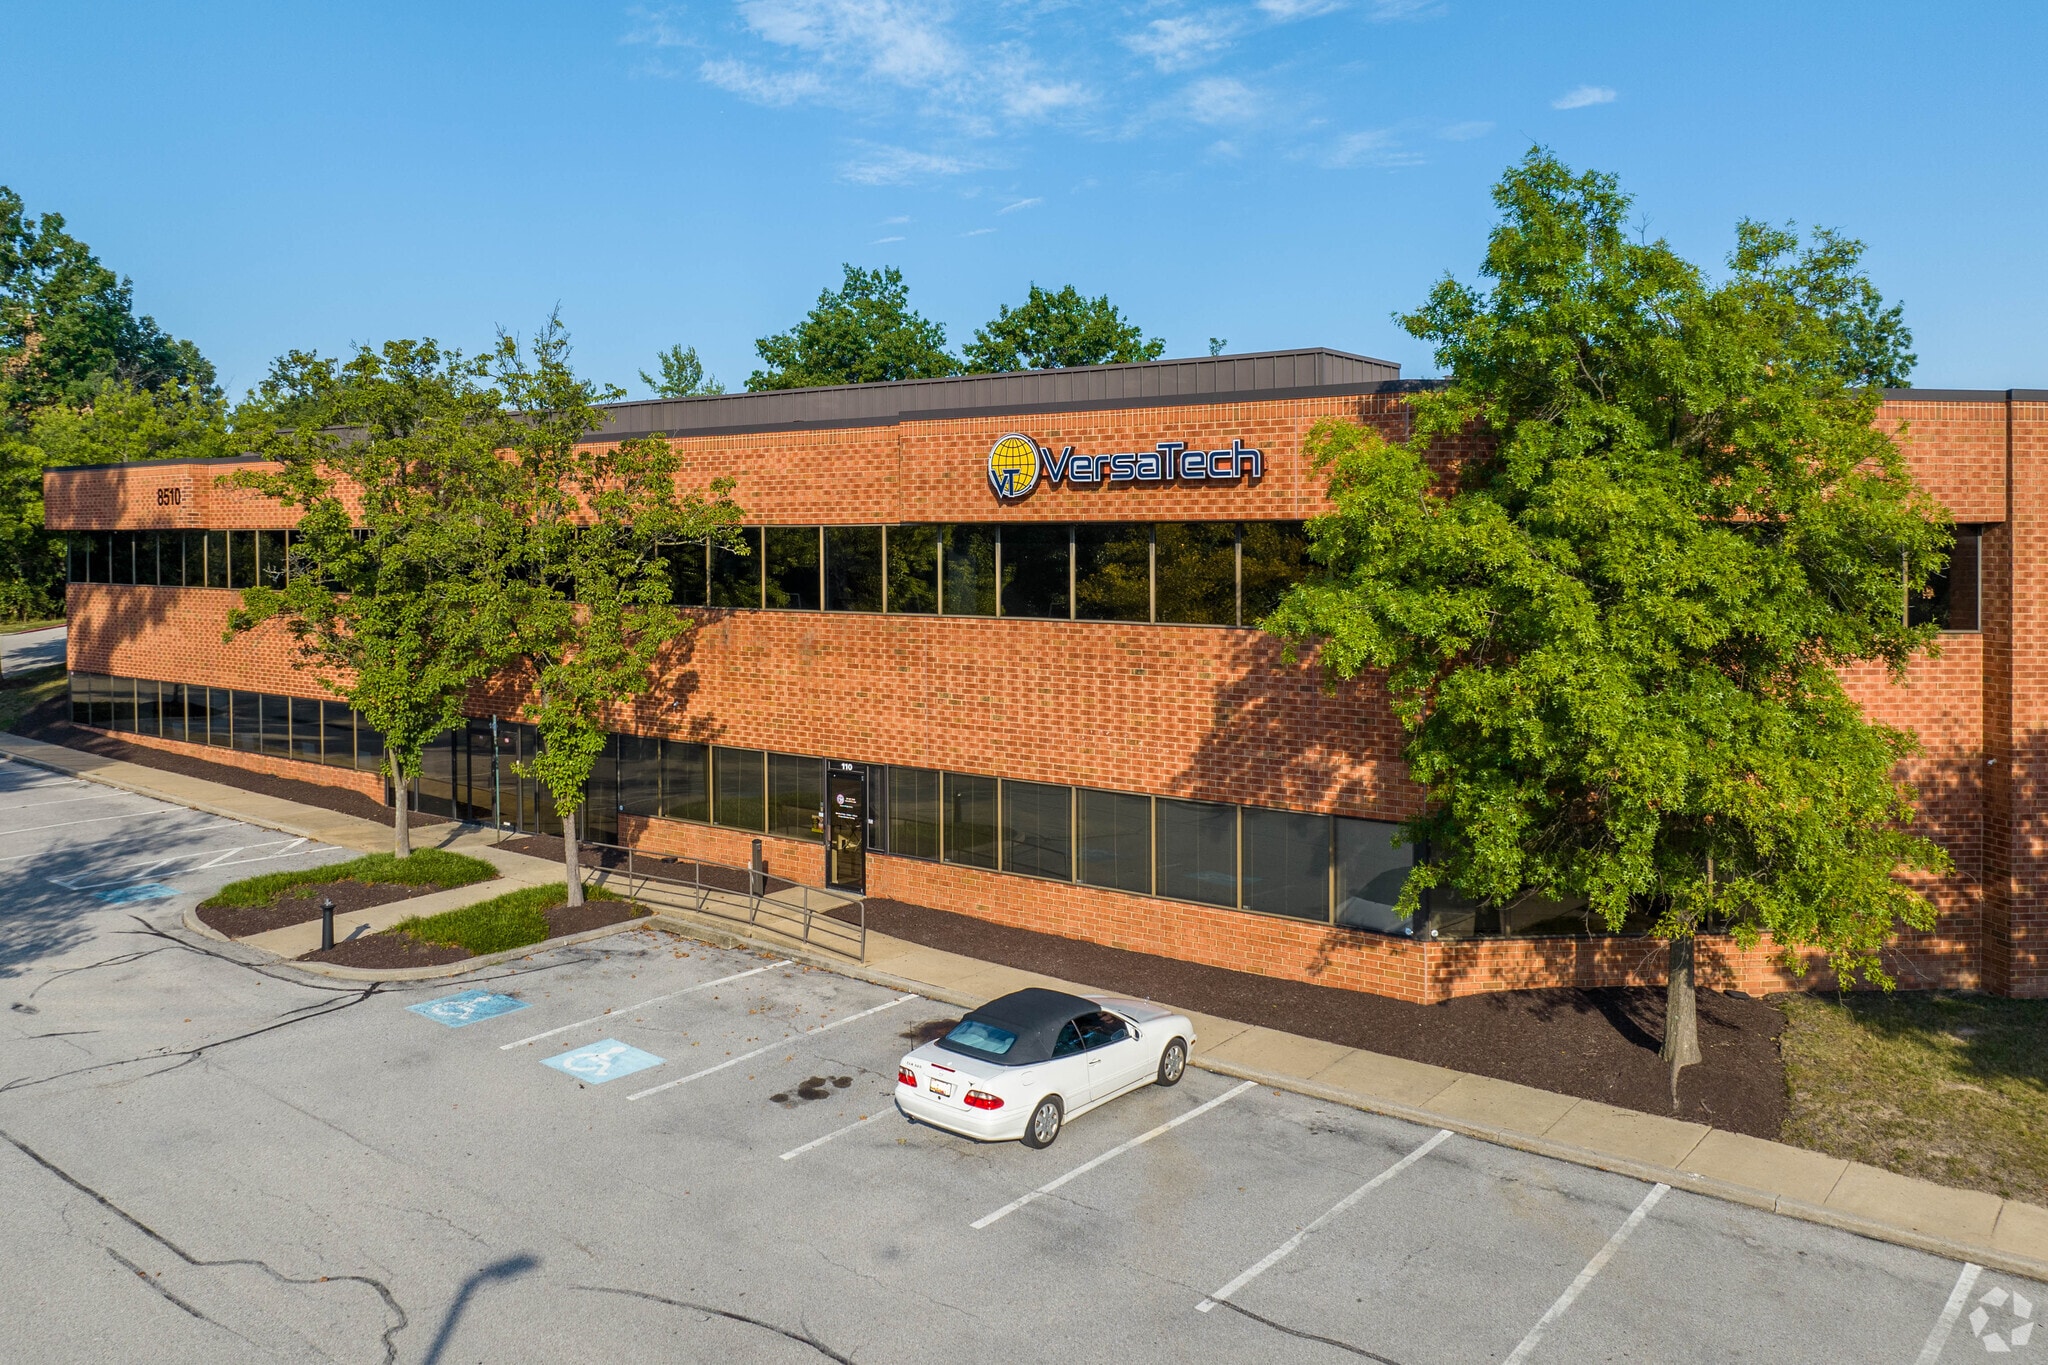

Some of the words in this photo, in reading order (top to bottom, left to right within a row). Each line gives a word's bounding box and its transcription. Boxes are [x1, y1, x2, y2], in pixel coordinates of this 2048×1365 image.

[1040, 439, 1262, 482] VersaTech
[990, 469, 1021, 498] VT
[157, 487, 181, 506] 8510
[841, 762, 853, 771] 110
